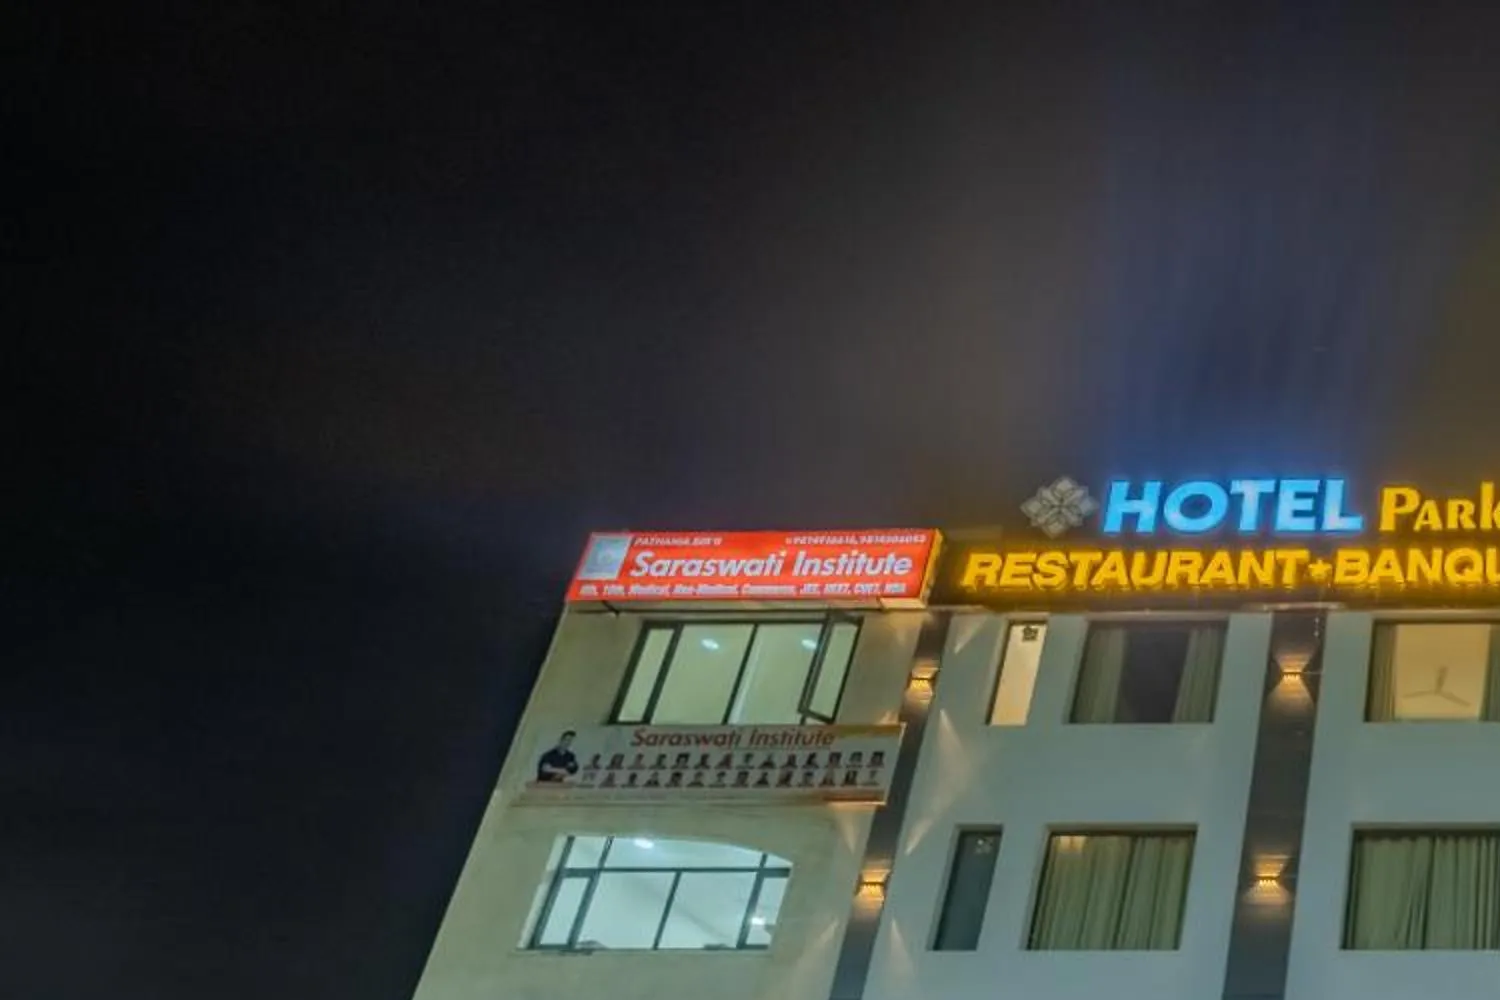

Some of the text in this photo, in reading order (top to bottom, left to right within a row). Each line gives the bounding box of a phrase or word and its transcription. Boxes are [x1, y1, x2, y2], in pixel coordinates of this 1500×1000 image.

[1103, 478, 1364, 534] HOTEL
[630, 549, 913, 577] Saraswati Institute
[962, 550, 1309, 589] RESTAURANT
[631, 728, 836, 749] Saraswati Institute
